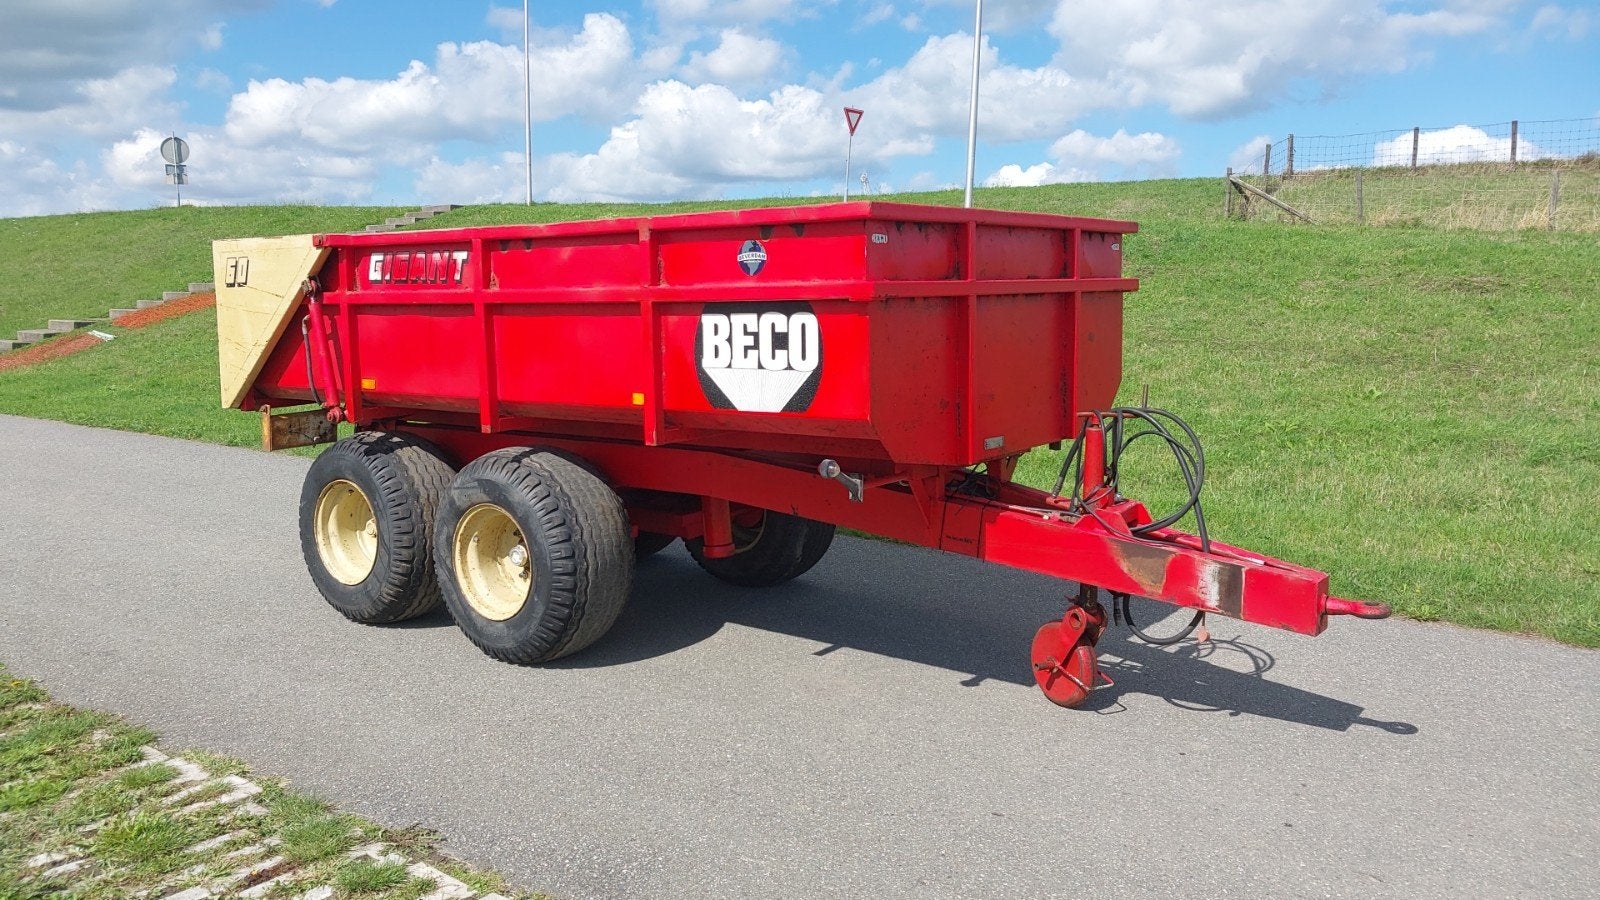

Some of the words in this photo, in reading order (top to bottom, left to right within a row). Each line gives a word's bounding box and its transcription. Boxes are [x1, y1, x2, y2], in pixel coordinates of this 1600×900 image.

[225, 256, 249, 287] 60
[368, 250, 469, 282] GIGANT
[701, 312, 819, 372] BECO
